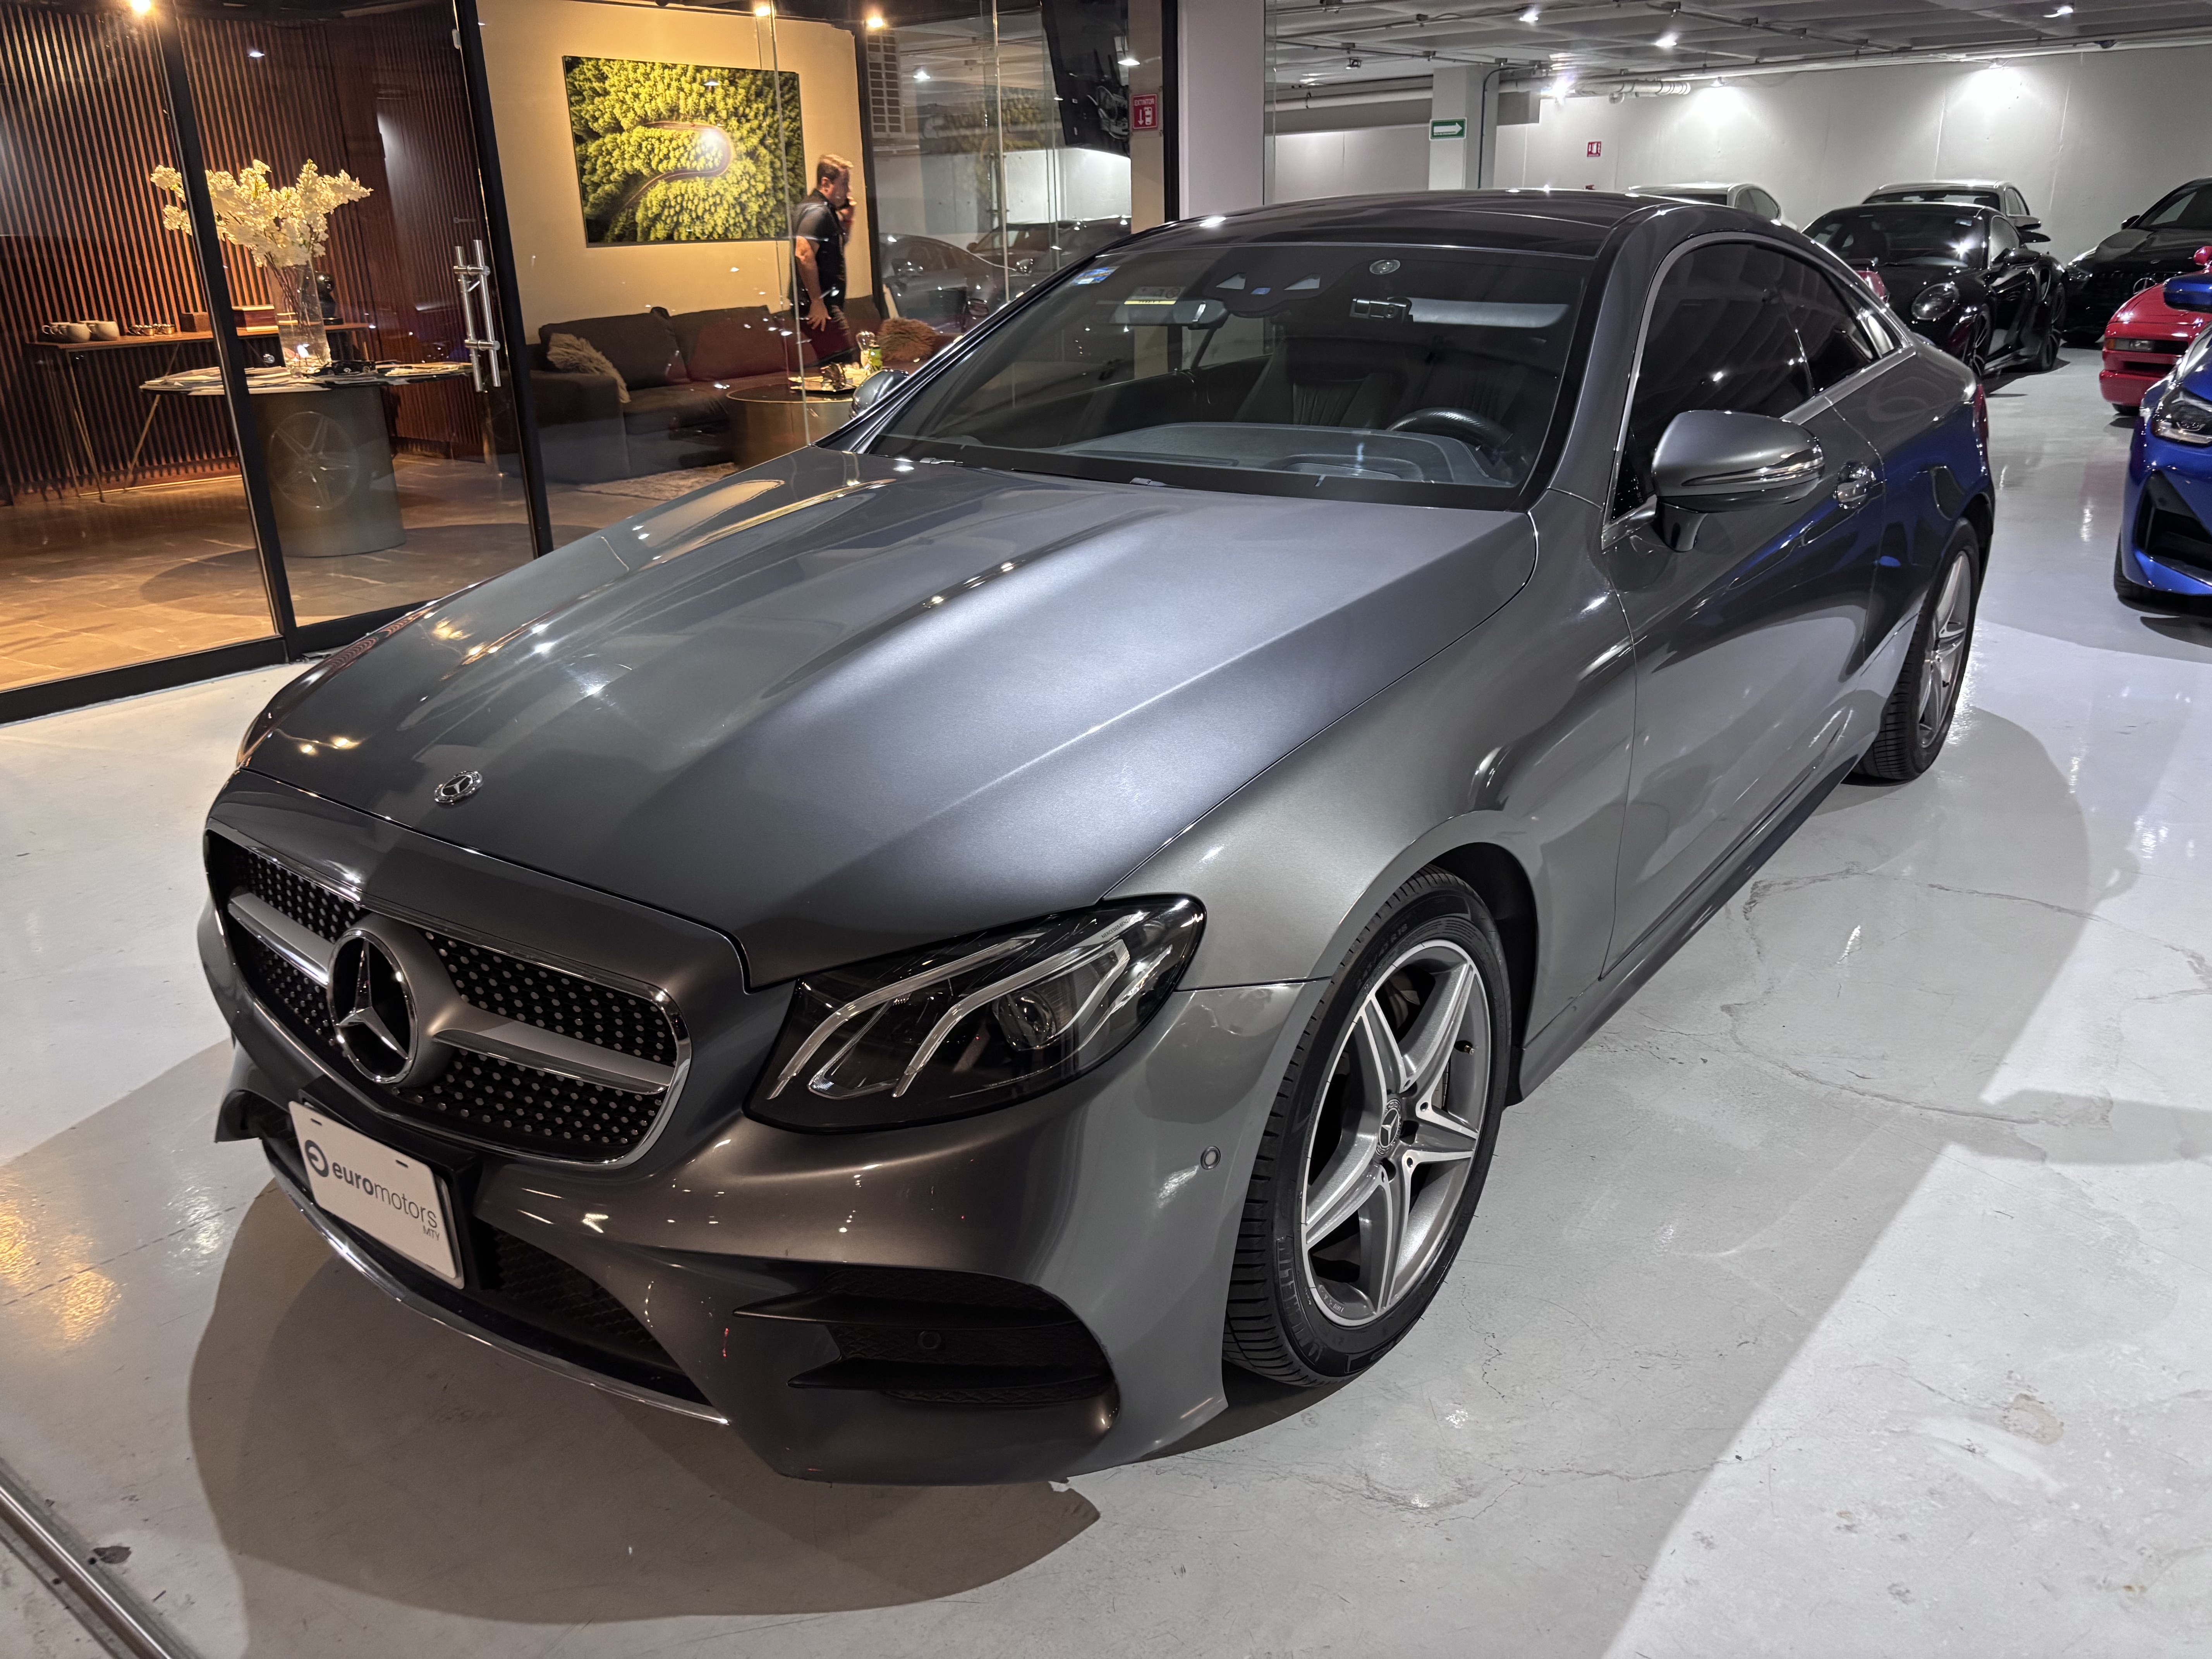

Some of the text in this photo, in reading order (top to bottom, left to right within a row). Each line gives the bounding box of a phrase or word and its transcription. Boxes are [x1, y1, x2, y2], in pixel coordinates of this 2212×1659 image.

[1101, 918, 1130, 939] MERCEDES-BENZ
[332, 1162, 438, 1229] euromotors
[423, 1225, 440, 1241] MTY
